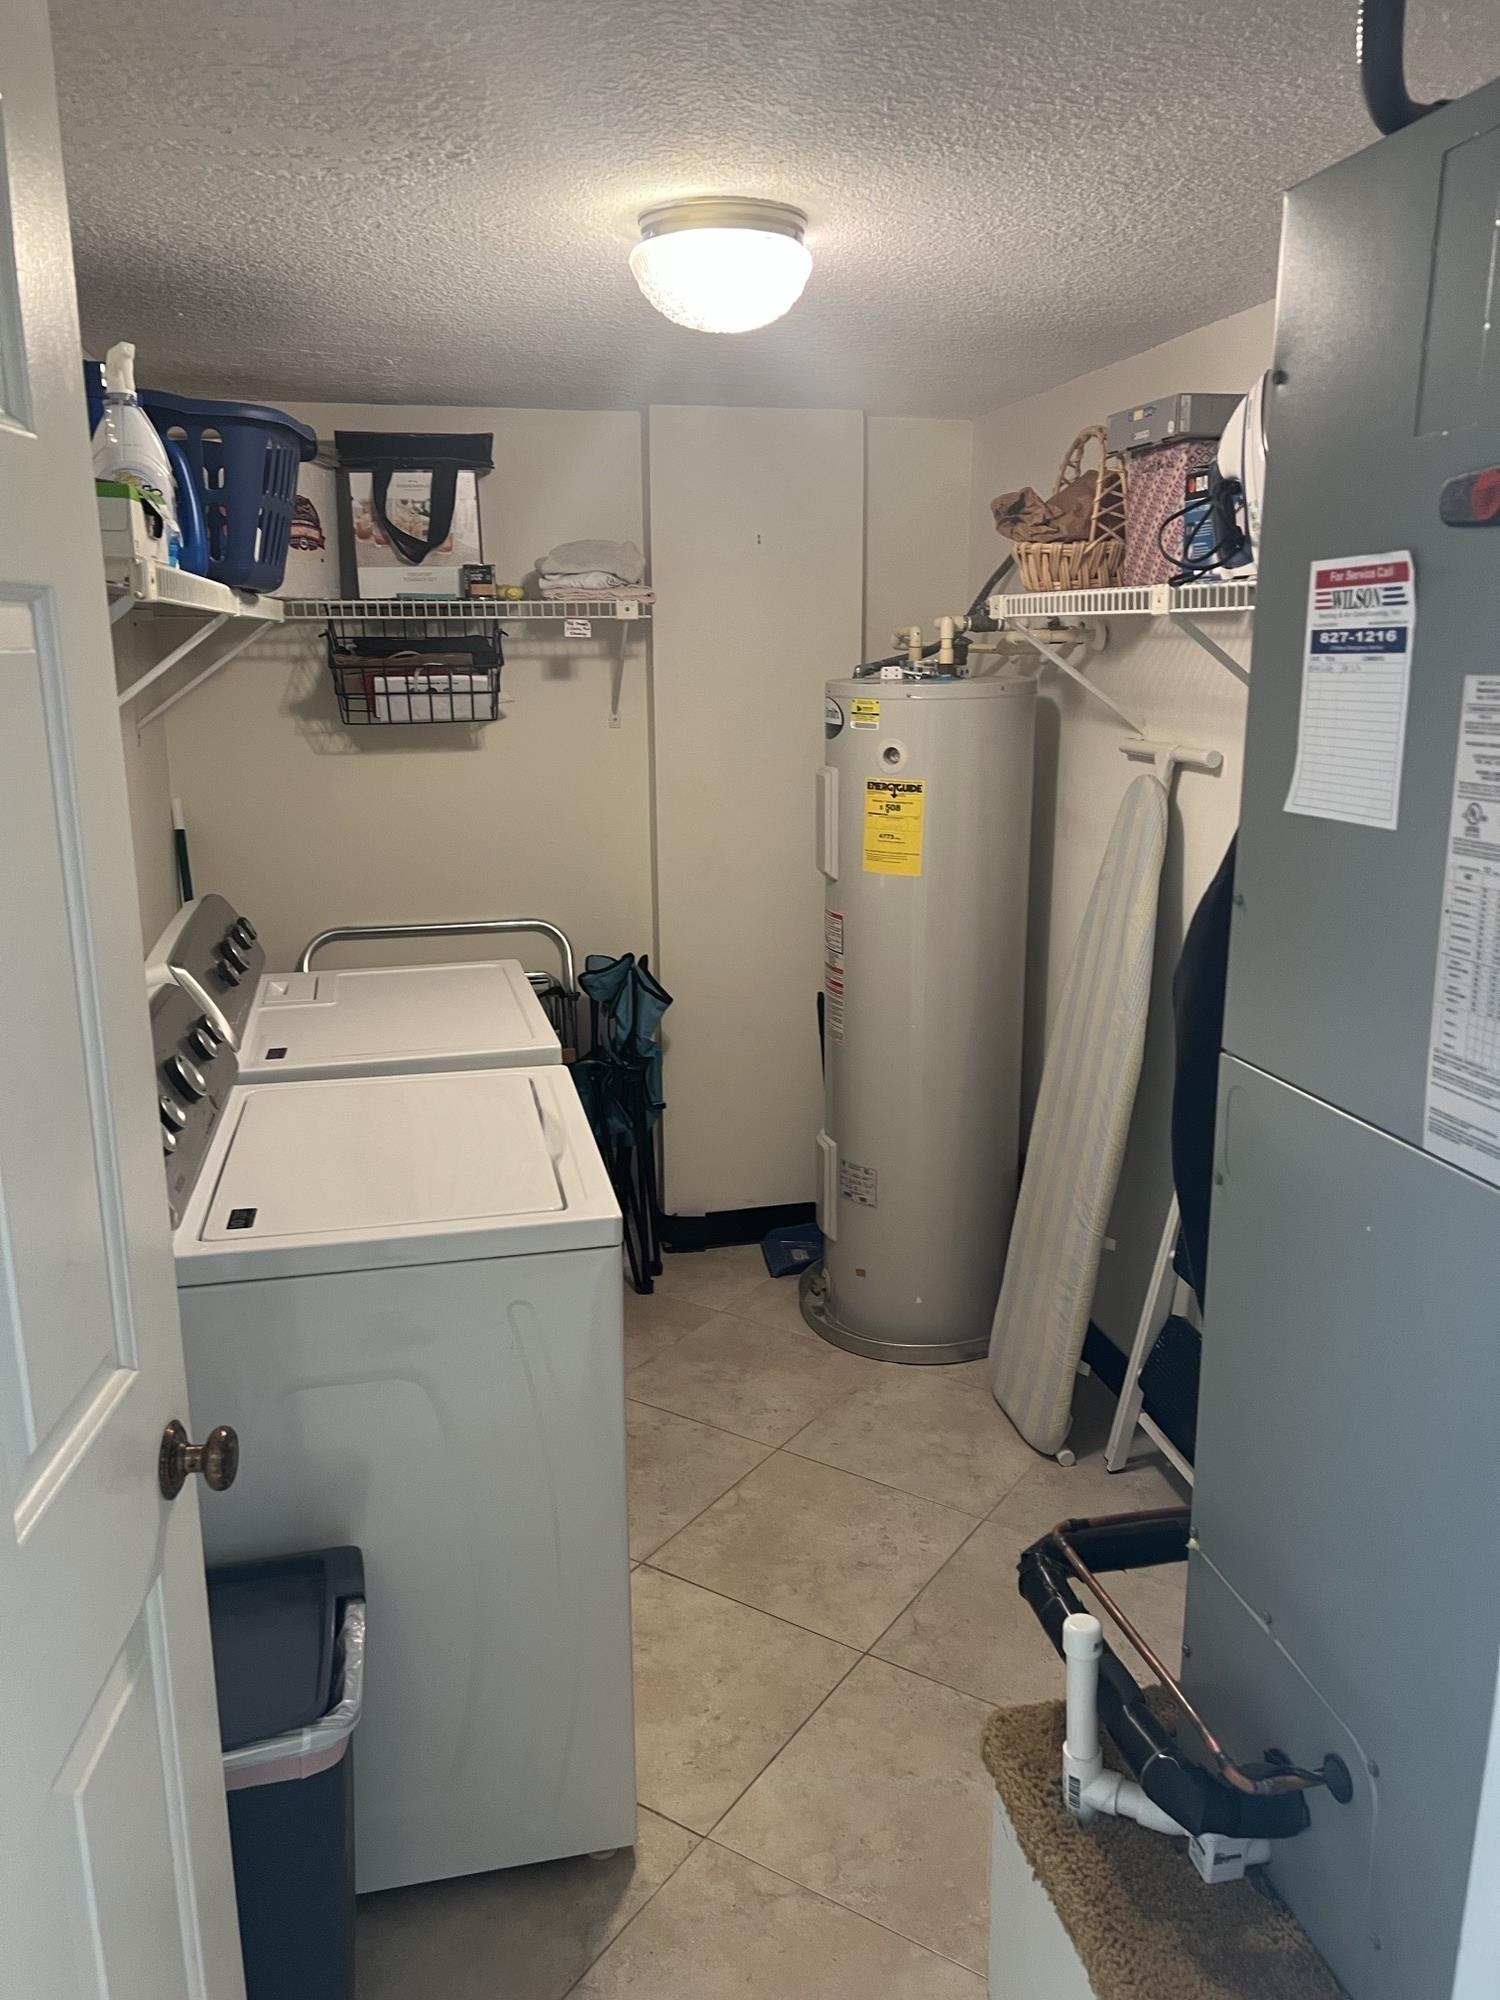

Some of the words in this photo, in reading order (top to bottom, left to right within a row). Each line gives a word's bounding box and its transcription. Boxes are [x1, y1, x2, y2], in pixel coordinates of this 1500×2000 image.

[1330, 571, 1344, 582] For
[1345, 569, 1375, 581] Service
[1377, 565, 1394, 578] Call
[1332, 587, 1381, 609] WILSON
[1320, 630, 1398, 643] 827-1216
